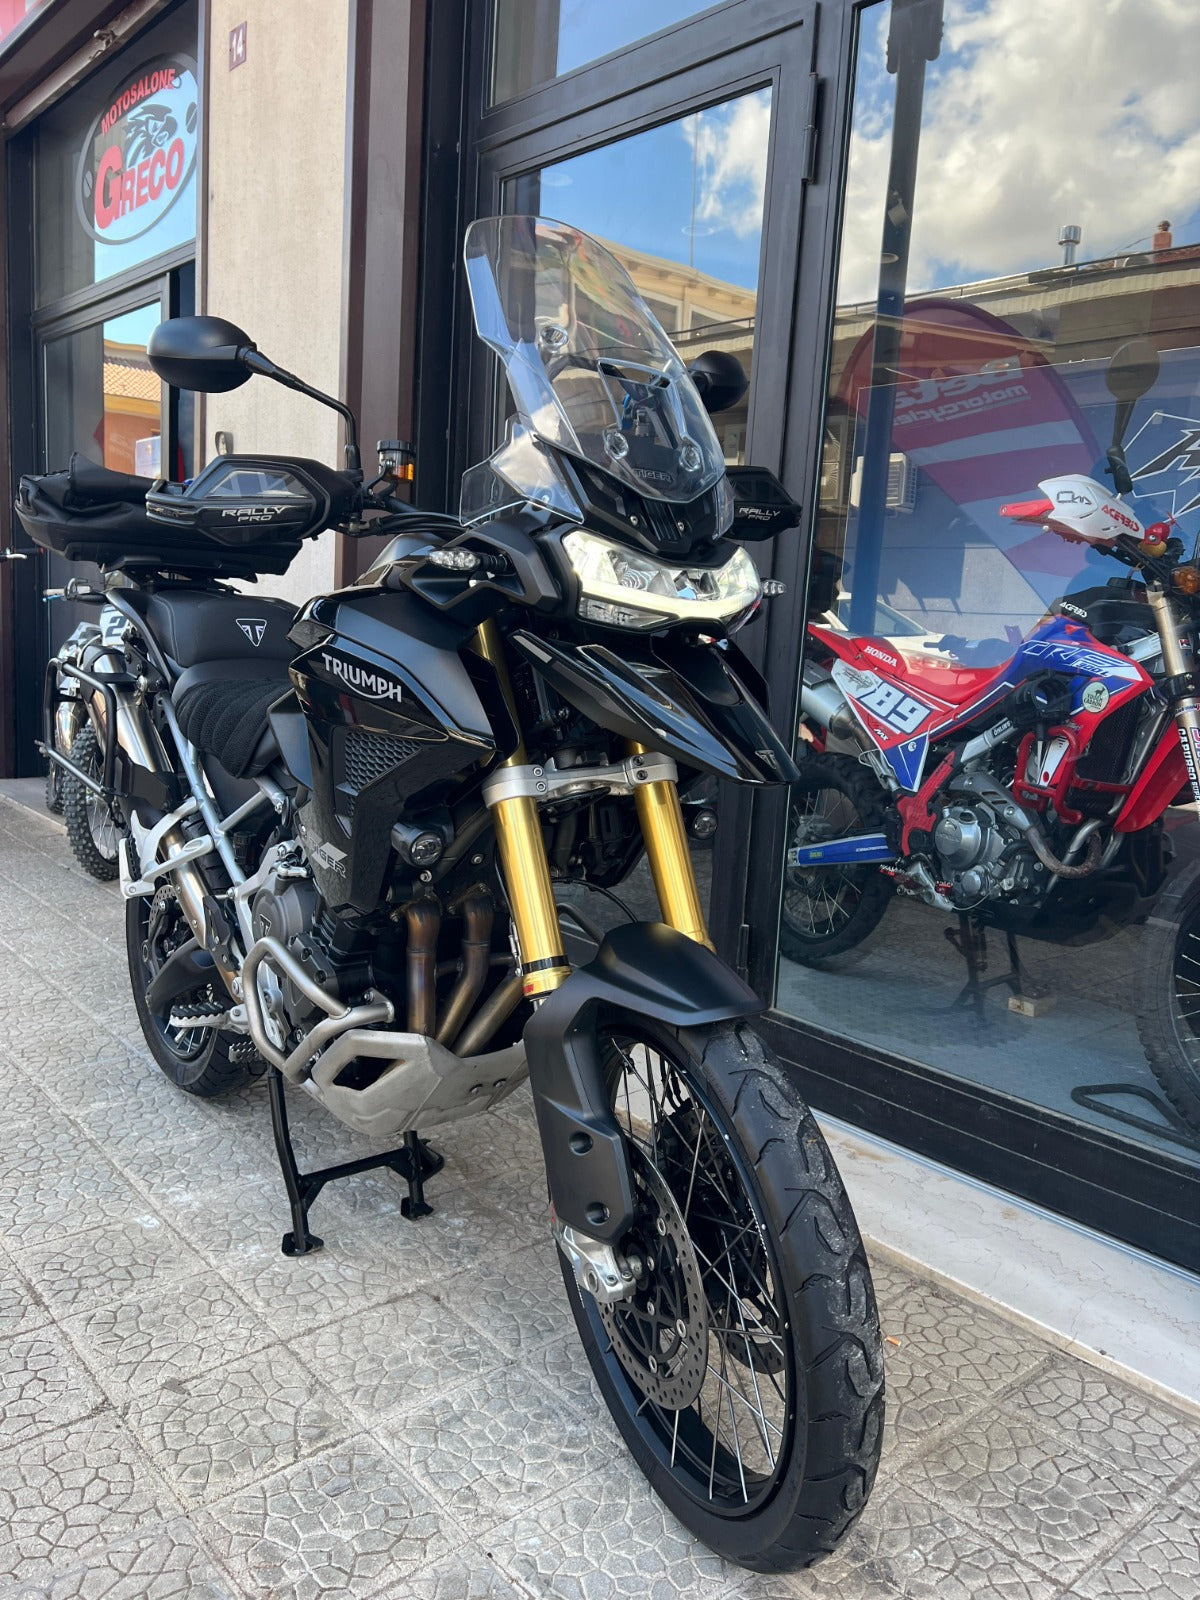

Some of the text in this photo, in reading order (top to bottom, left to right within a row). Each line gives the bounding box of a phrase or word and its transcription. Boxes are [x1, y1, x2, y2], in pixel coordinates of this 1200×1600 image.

[231, 31, 243, 62] 14
[101, 68, 176, 136] MOTOSALONE
[94, 138, 185, 230] GRECO
[633, 468, 675, 484] TIGER
[222, 505, 288, 517] RALLY
[237, 514, 273, 522] PRO
[738, 507, 780, 517] RALLY
[1101, 504, 1140, 532] ACERBIS
[1059, 601, 1088, 618] ACERBIS
[864, 645, 898, 667] HONDA
[321, 652, 402, 703] TRIUMPH
